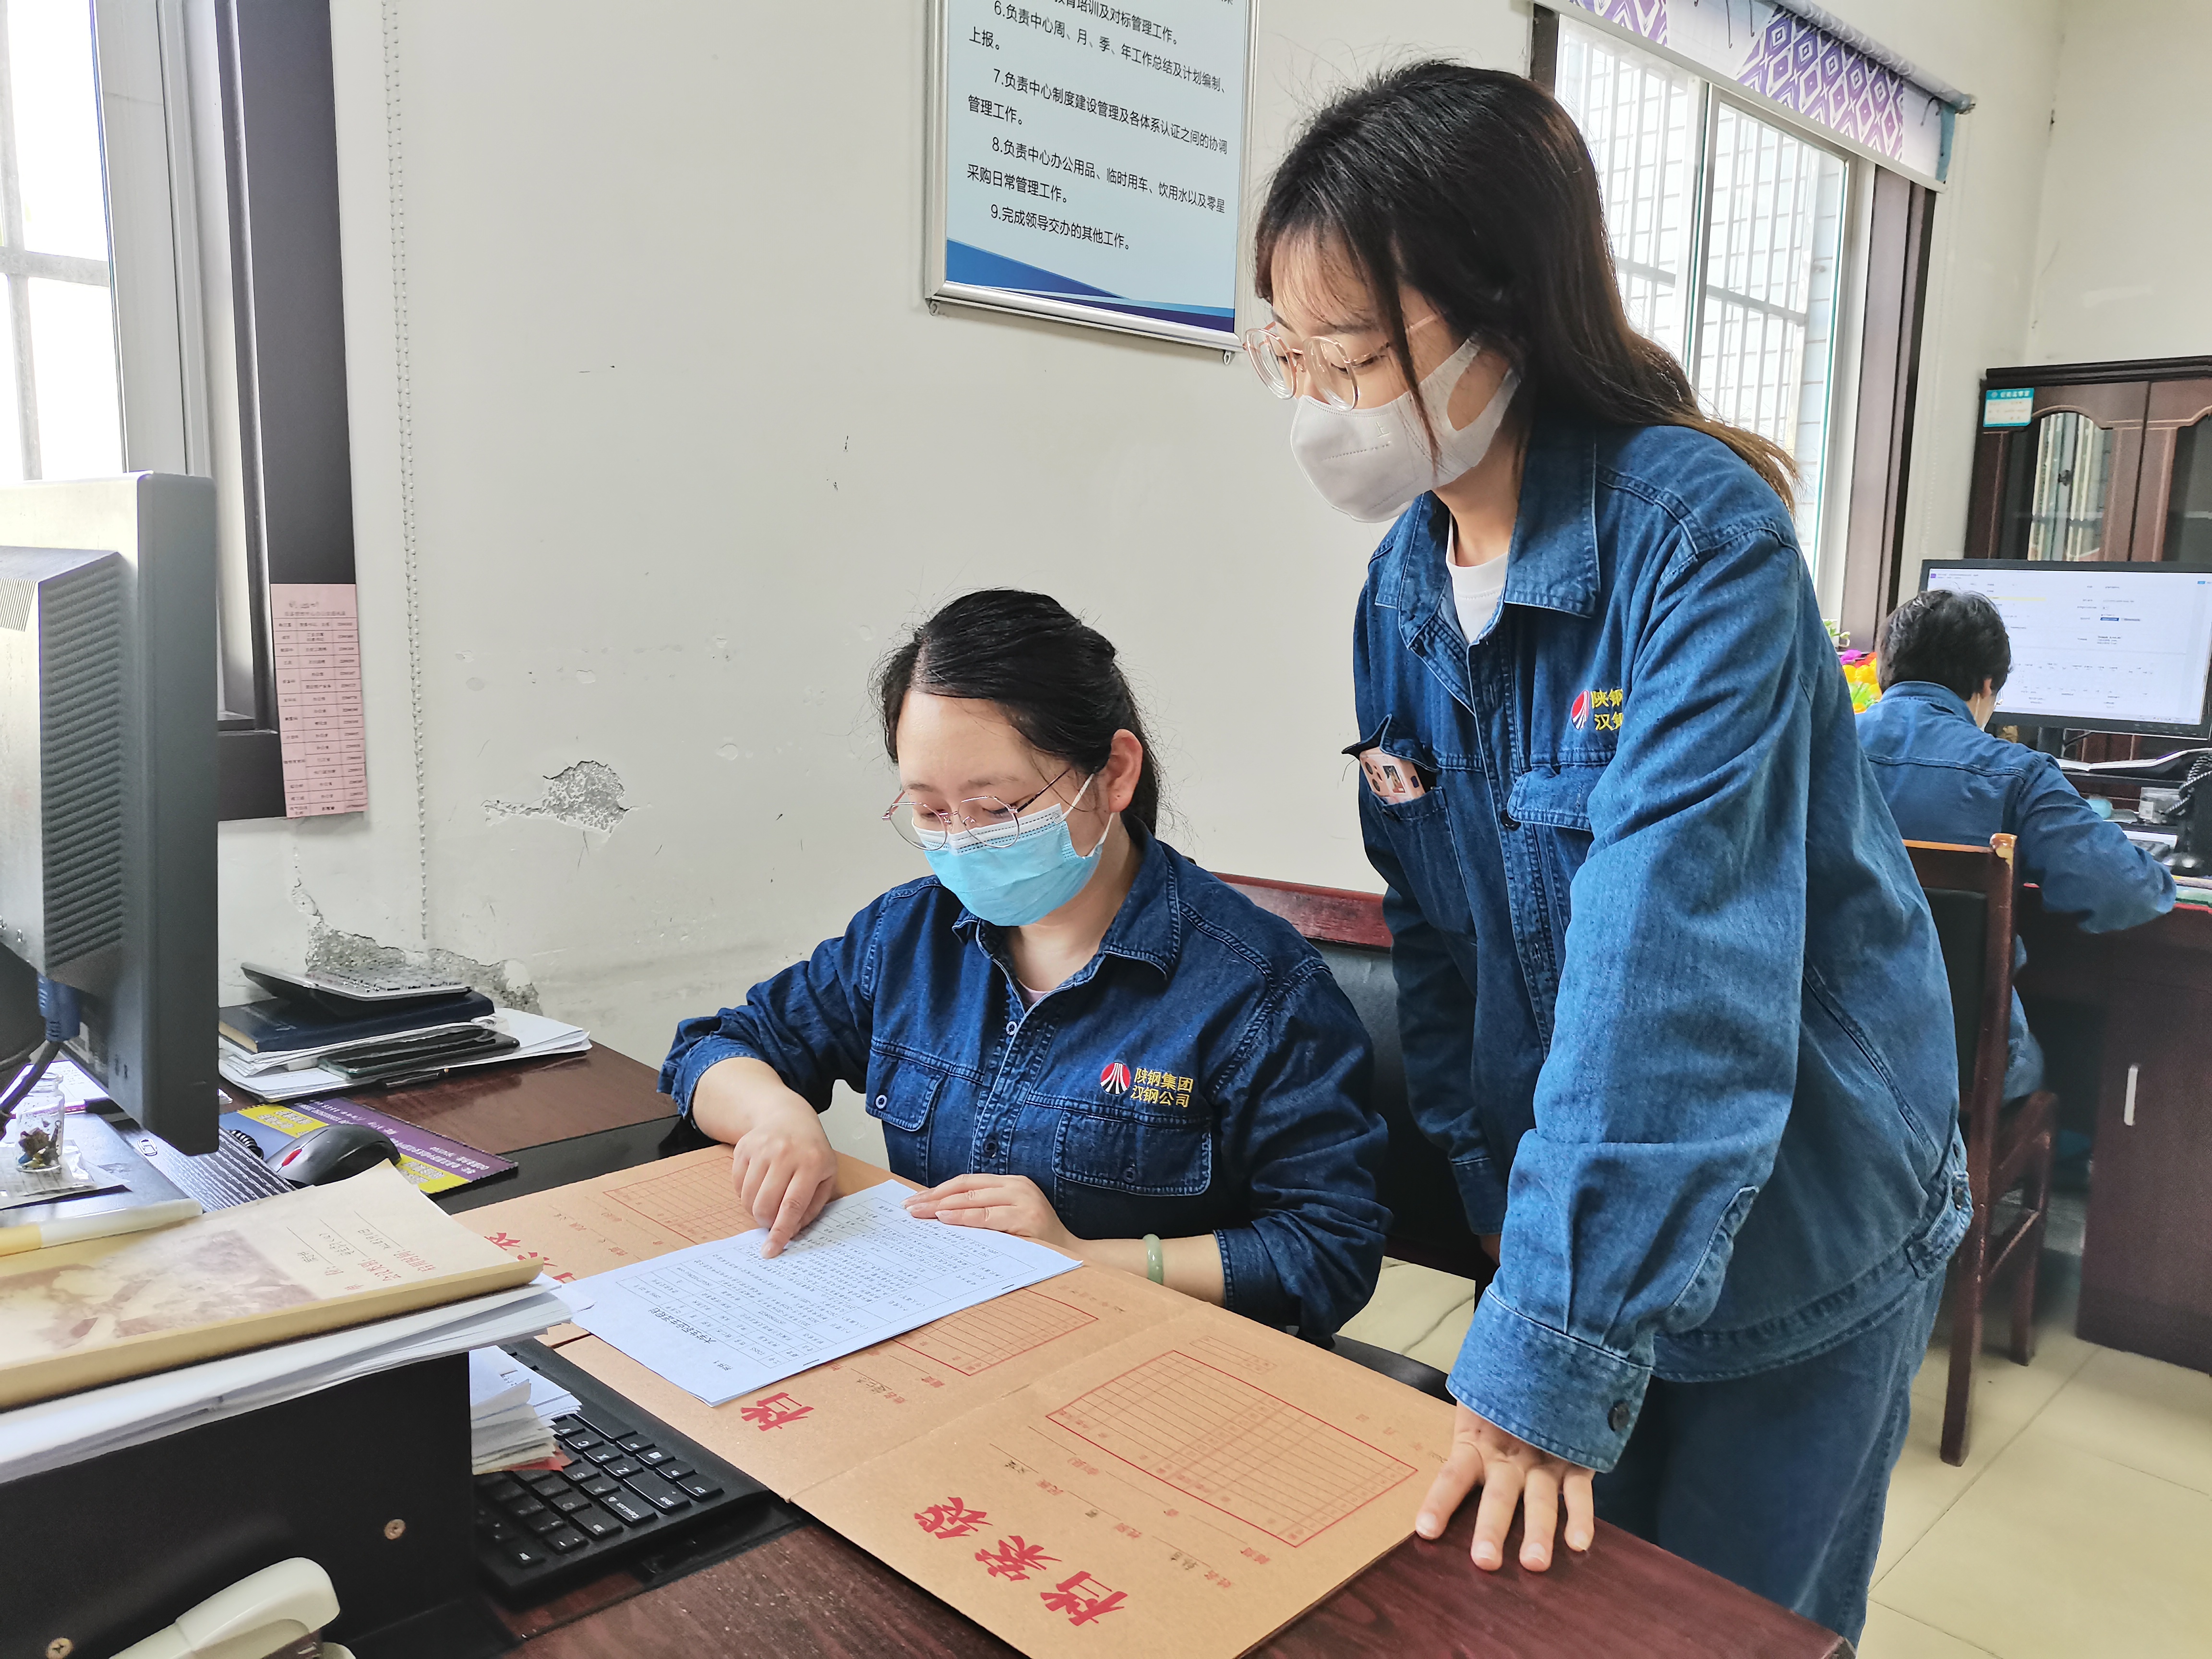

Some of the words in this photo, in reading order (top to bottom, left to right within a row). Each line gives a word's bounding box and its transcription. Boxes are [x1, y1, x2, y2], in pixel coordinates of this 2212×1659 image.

[969, 26, 1000, 50] 上报。
[1055, 0, 1177, 45] 育培训及对标管理工作。
[968, 94, 1023, 125] 管理工作。
[993, 68, 1227, 155] 7.负责中心制度建设管理及各体系认证之间的协调
[967, 164, 1067, 203] 采购日常管理工作。
[991, 204, 1129, 250] 9.完成领导交办的其他工作。
[1130, 1084, 1190, 1108] 汉钢公司
[1134, 1067, 1194, 1093] 陕钢集团
[914, 1497, 1128, 1627] 档案袋
